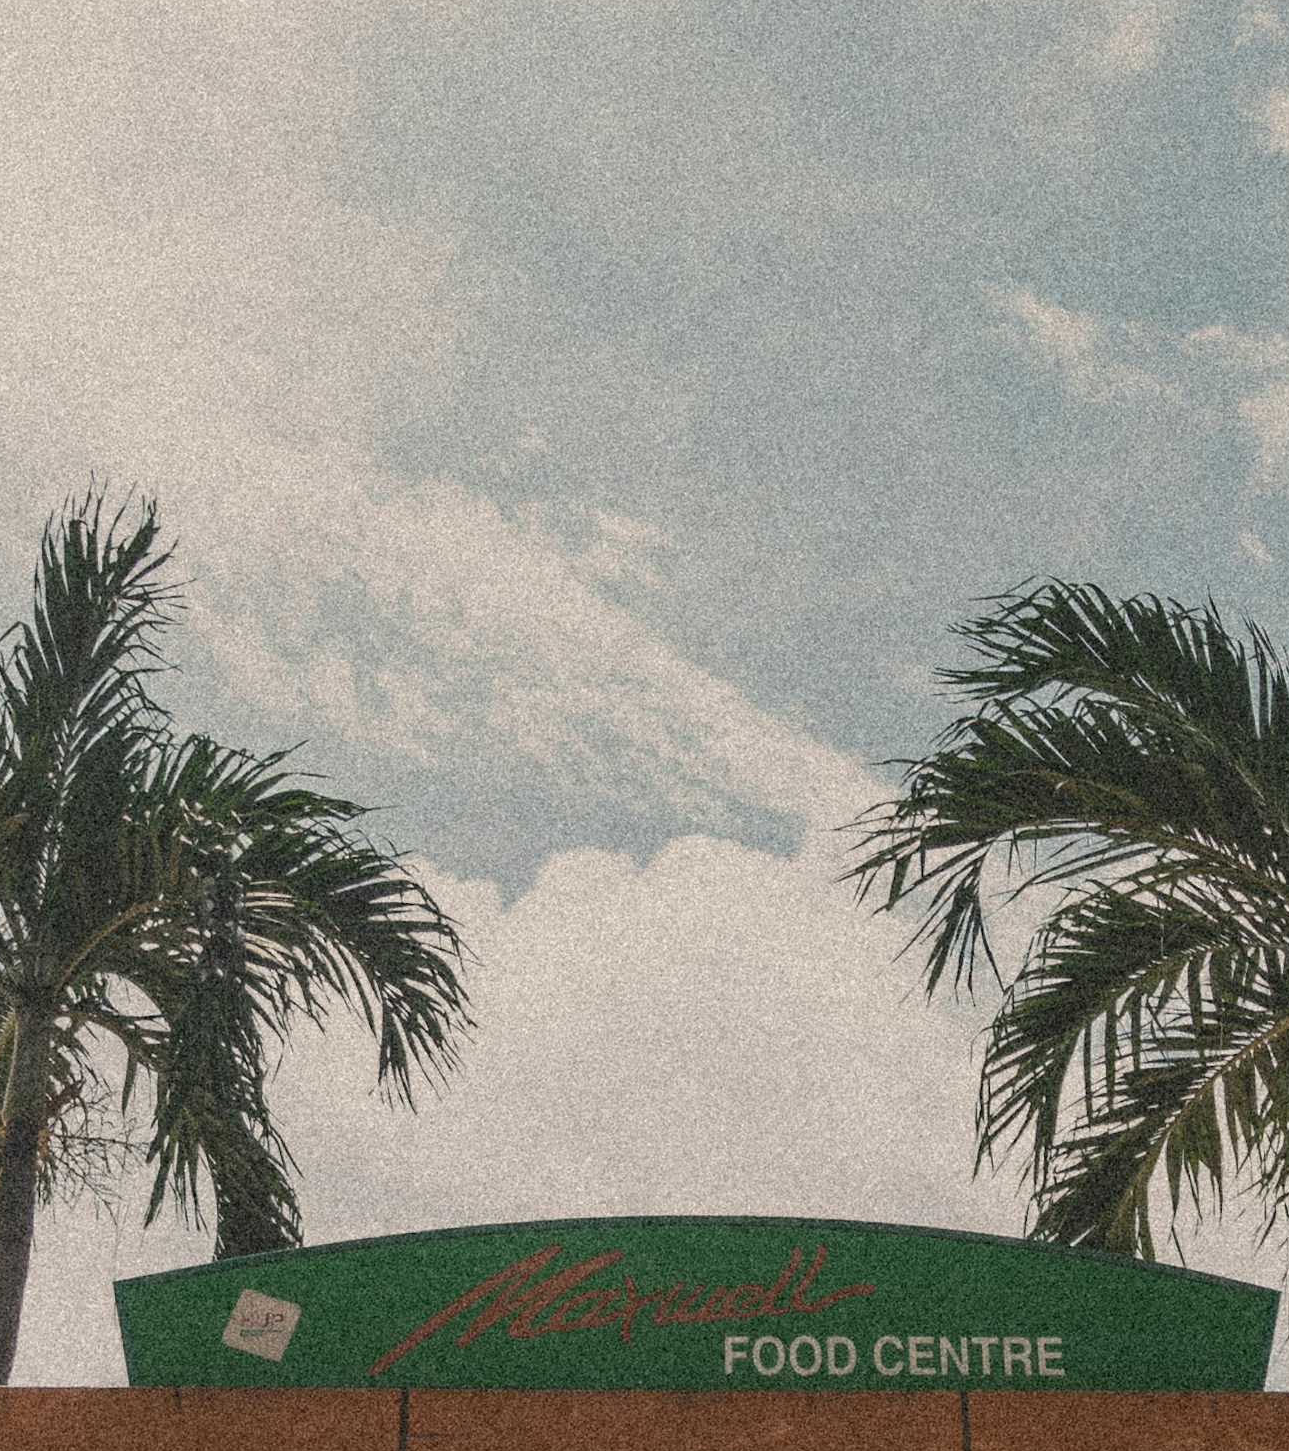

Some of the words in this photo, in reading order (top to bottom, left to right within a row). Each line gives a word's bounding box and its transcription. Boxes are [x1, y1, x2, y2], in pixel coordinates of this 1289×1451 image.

[370, 1244, 876, 1375] Maxwell
[724, 1336, 858, 1376] FOOD
[873, 1337, 1065, 1377] CENTRE
